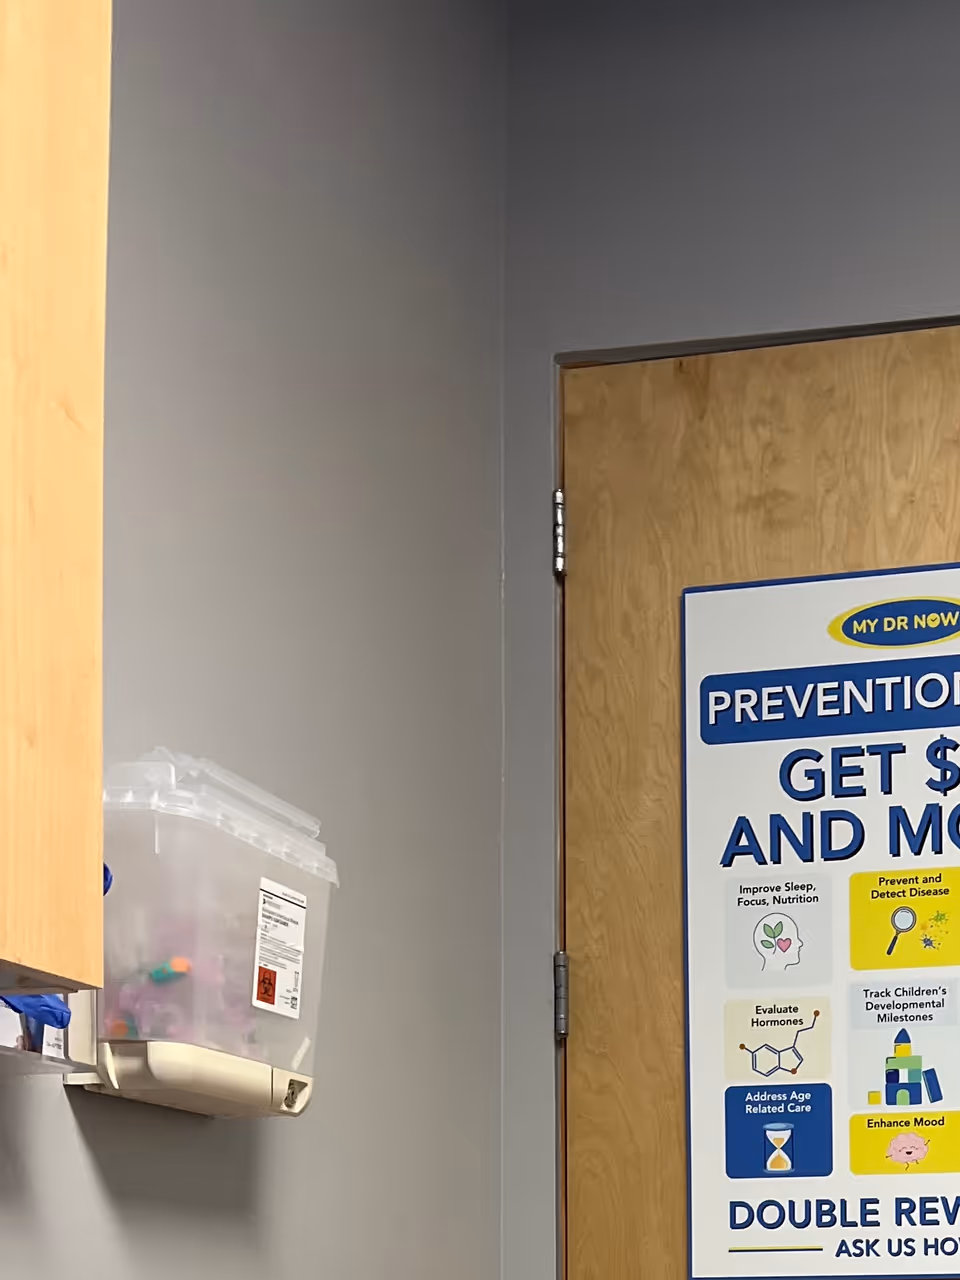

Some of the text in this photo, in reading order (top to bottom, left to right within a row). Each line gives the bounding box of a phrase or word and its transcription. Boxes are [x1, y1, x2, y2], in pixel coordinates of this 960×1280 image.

[853, 612, 960, 634] MY DR NOW
[780, 743, 905, 802] GET
[720, 809, 864, 867] AND
[879, 874, 942, 887] Prevent and
[739, 881, 816, 895] Improve Sleep,
[871, 886, 950, 899] Detect Disease
[737, 893, 819, 907] Focus, Nutrition
[863, 984, 946, 998] Track Children's
[755, 1004, 798, 1016] Evaluate
[865, 998, 945, 1014] Developmental
[751, 1015, 804, 1028] Hormones
[877, 1011, 933, 1024] Milestones
[745, 1090, 811, 1104] Address Age
[745, 1102, 811, 1114] Related Care
[867, 1116, 945, 1129] Enhance Mood
[729, 1198, 881, 1230] DOUBLE
[835, 1239, 881, 1258] ASK
[887, 1238, 916, 1257] US
